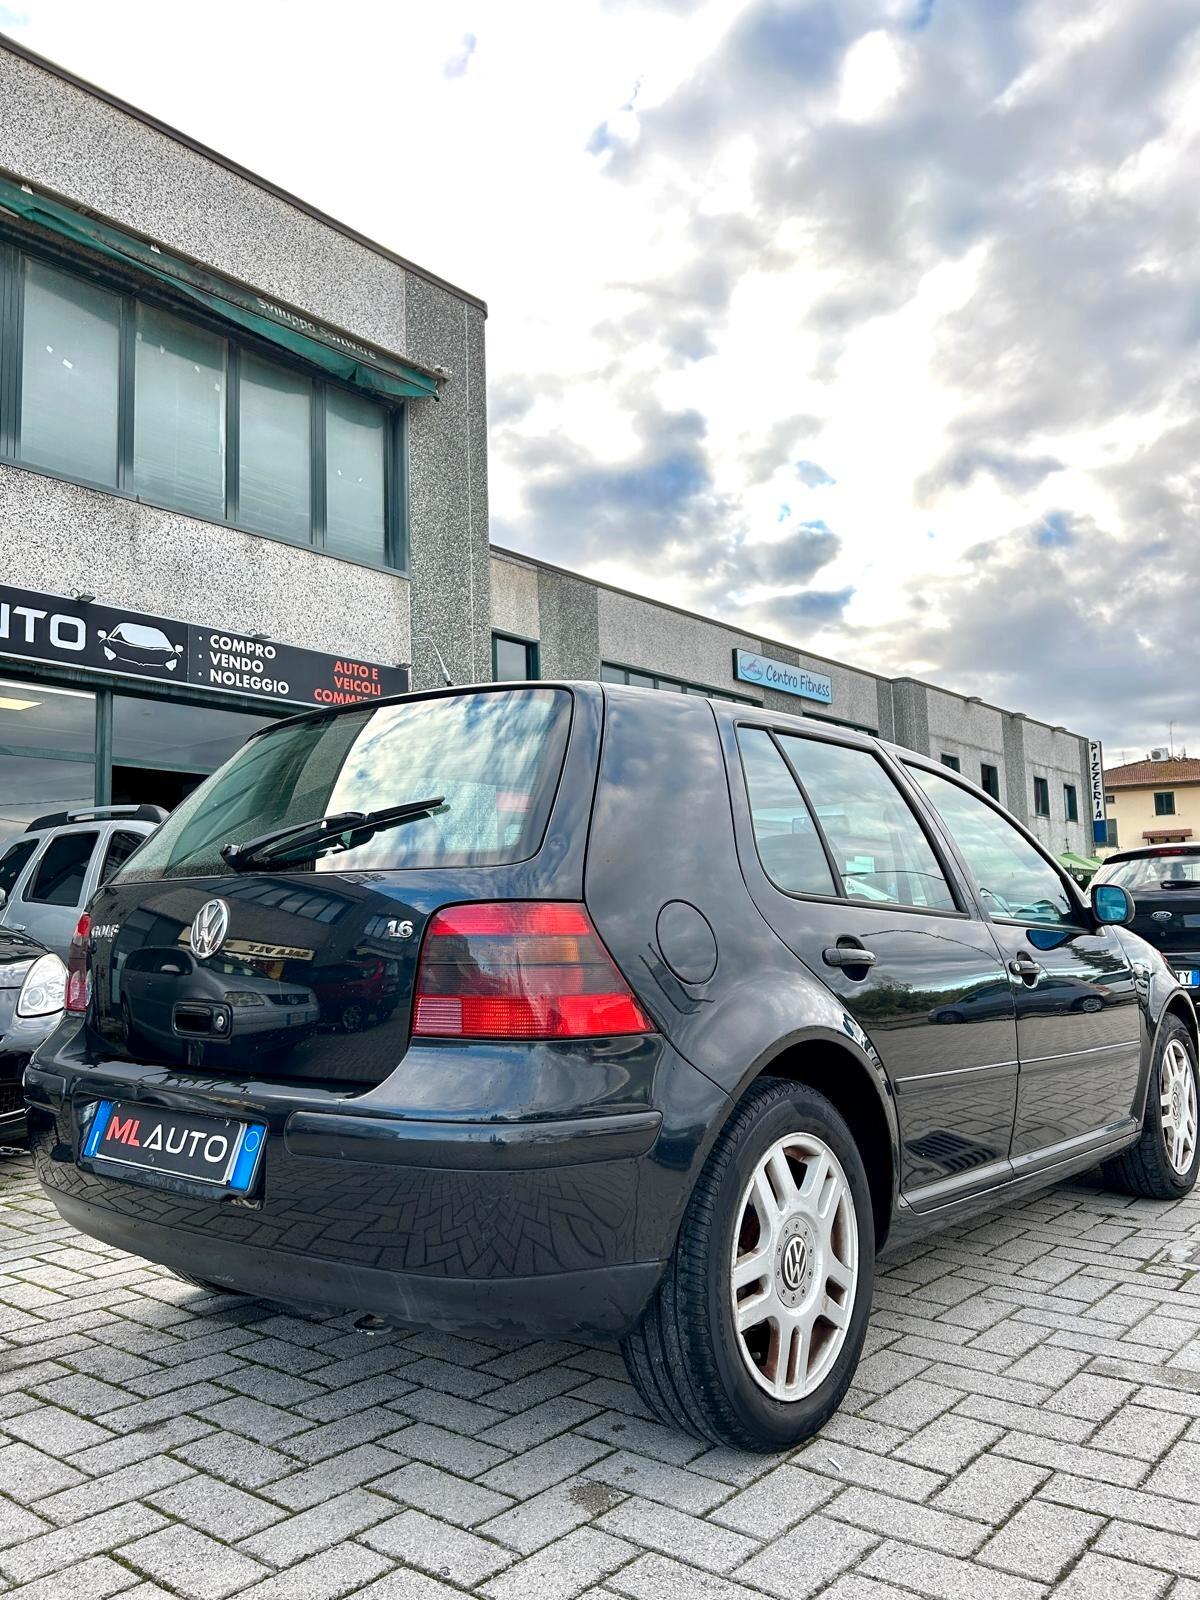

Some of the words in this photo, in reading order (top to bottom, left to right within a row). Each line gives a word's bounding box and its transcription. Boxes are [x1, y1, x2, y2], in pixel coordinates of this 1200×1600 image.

[257, 298, 316, 333] Sviluppo
[0, 602, 86, 651] TO
[210, 634, 276, 659] COMPRO
[209, 651, 264, 673] VENDO
[334, 660, 369, 678] AUTO
[372, 667, 379, 680] E
[209, 668, 290, 694] NOLEGGIO
[334, 675, 381, 695] VEICOLI
[766, 664, 798, 688] Centro
[800, 674, 830, 697] Fitness
[1090, 743, 1103, 820] PIZZERIA
